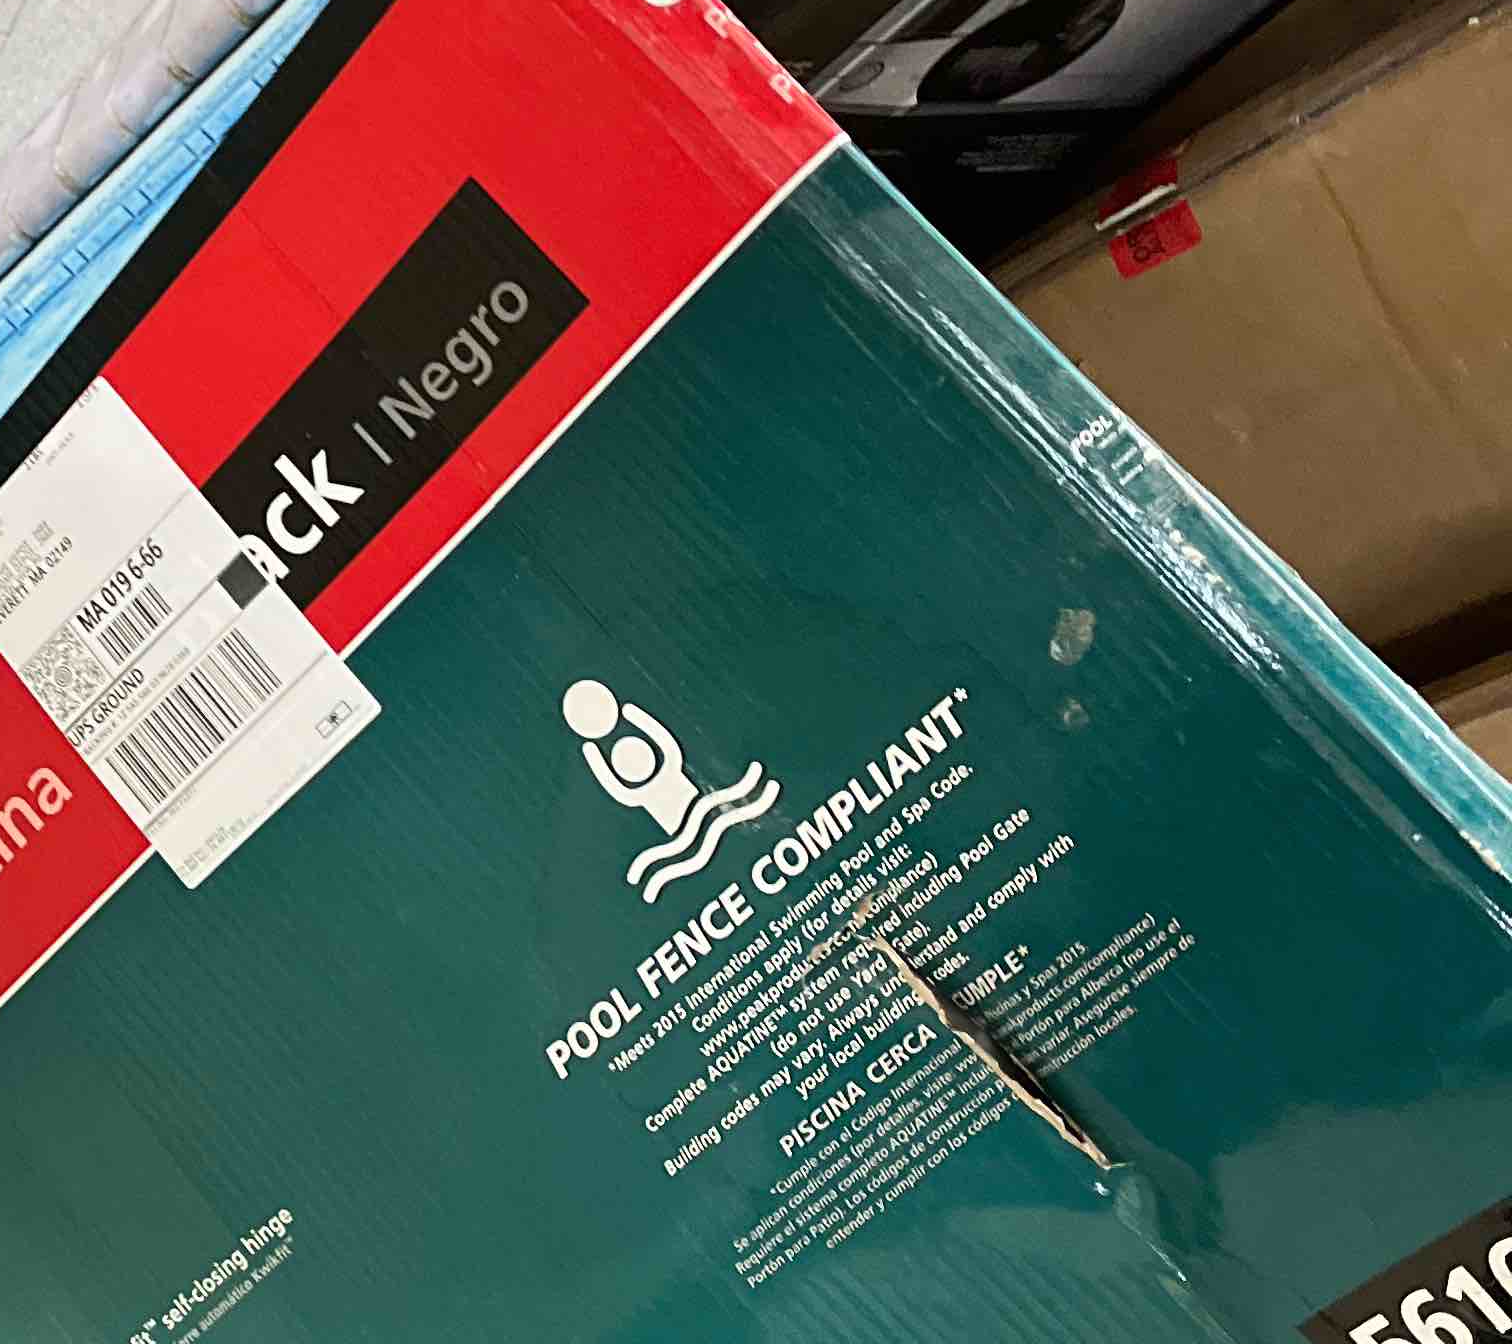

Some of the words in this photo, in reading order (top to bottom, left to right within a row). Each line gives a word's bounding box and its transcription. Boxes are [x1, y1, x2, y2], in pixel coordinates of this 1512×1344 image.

[380, 278, 531, 445] Negro
[75, 599, 108, 632] MA
[100, 570, 131, 607] 019
[127, 537, 162, 579] 6-66
[92, 667, 145, 724] GROUND
[546, 988, 641, 1078] POOL
[637, 883, 753, 997] FENCE
[645, 1077, 706, 1131] Complete
[788, 966, 840, 1012] system
[898, 865, 962, 918] including
[958, 833, 993, 869] Pool
[992, 808, 1029, 840] Gate
[651, 1002, 686, 1038] 2015
[684, 930, 770, 1009] International
[768, 872, 843, 937] Swimming
[839, 841, 874, 876] Pool
[873, 816, 903, 849] and
[901, 796, 931, 824] Spa
[691, 970, 763, 1032] Conditions
[763, 935, 802, 974] apply
[800, 911, 829, 941] (for
[830, 873, 877, 915] details
[875, 843, 912, 876] visit:
[663, 1125, 721, 1176] Building
[720, 1092, 759, 1129] codes
[759, 1065, 791, 1097] may
[827, 993, 879, 1041] Always
[957, 901, 986, 933] and
[987, 863, 1037, 909] comply
[1037, 834, 1074, 868] with
[769, 1031, 797, 1058] (do
[797, 1007, 825, 1035] not
[824, 986, 851, 1012] use
[849, 952, 888, 988] Yard
[795, 1062, 829, 1100] your
[827, 1031, 864, 1067] local
[734, 1232, 783, 1274] Requiere
[783, 1219, 796, 1236] el
[794, 1188, 838, 1227] sistema
[837, 1147, 888, 1192] completo
[1053, 996, 1080, 1023] para
[1080, 964, 1123, 1000] Alberca
[1144, 930, 1166, 951] use
[1167, 916, 1181, 934] el
[779, 1081, 865, 1156] PISCINA
[866, 1023, 936, 1083] CERCA
[783, 1234, 810, 1261] para
[843, 1189, 867, 1209] Los
[908, 1141, 925, 1158] de
[1130, 947, 1176, 987] siempre
[1177, 934, 1195, 951] de
[817, 1139, 840, 1160] con
[839, 1125, 852, 1142] el
[889, 1037, 961, 1100] Internacional
[749, 1205, 788, 1241] aplican
[788, 1153, 851, 1208] condiciones
[825, 1205, 874, 1248] entender
[875, 1197, 884, 1212] y
[884, 1164, 925, 1202] cumplir
[926, 1147, 949, 1168] con
[946, 1131, 967, 1151] los
[161, 1249, 248, 1329] self-closing
[239, 1208, 292, 1254] hinge
